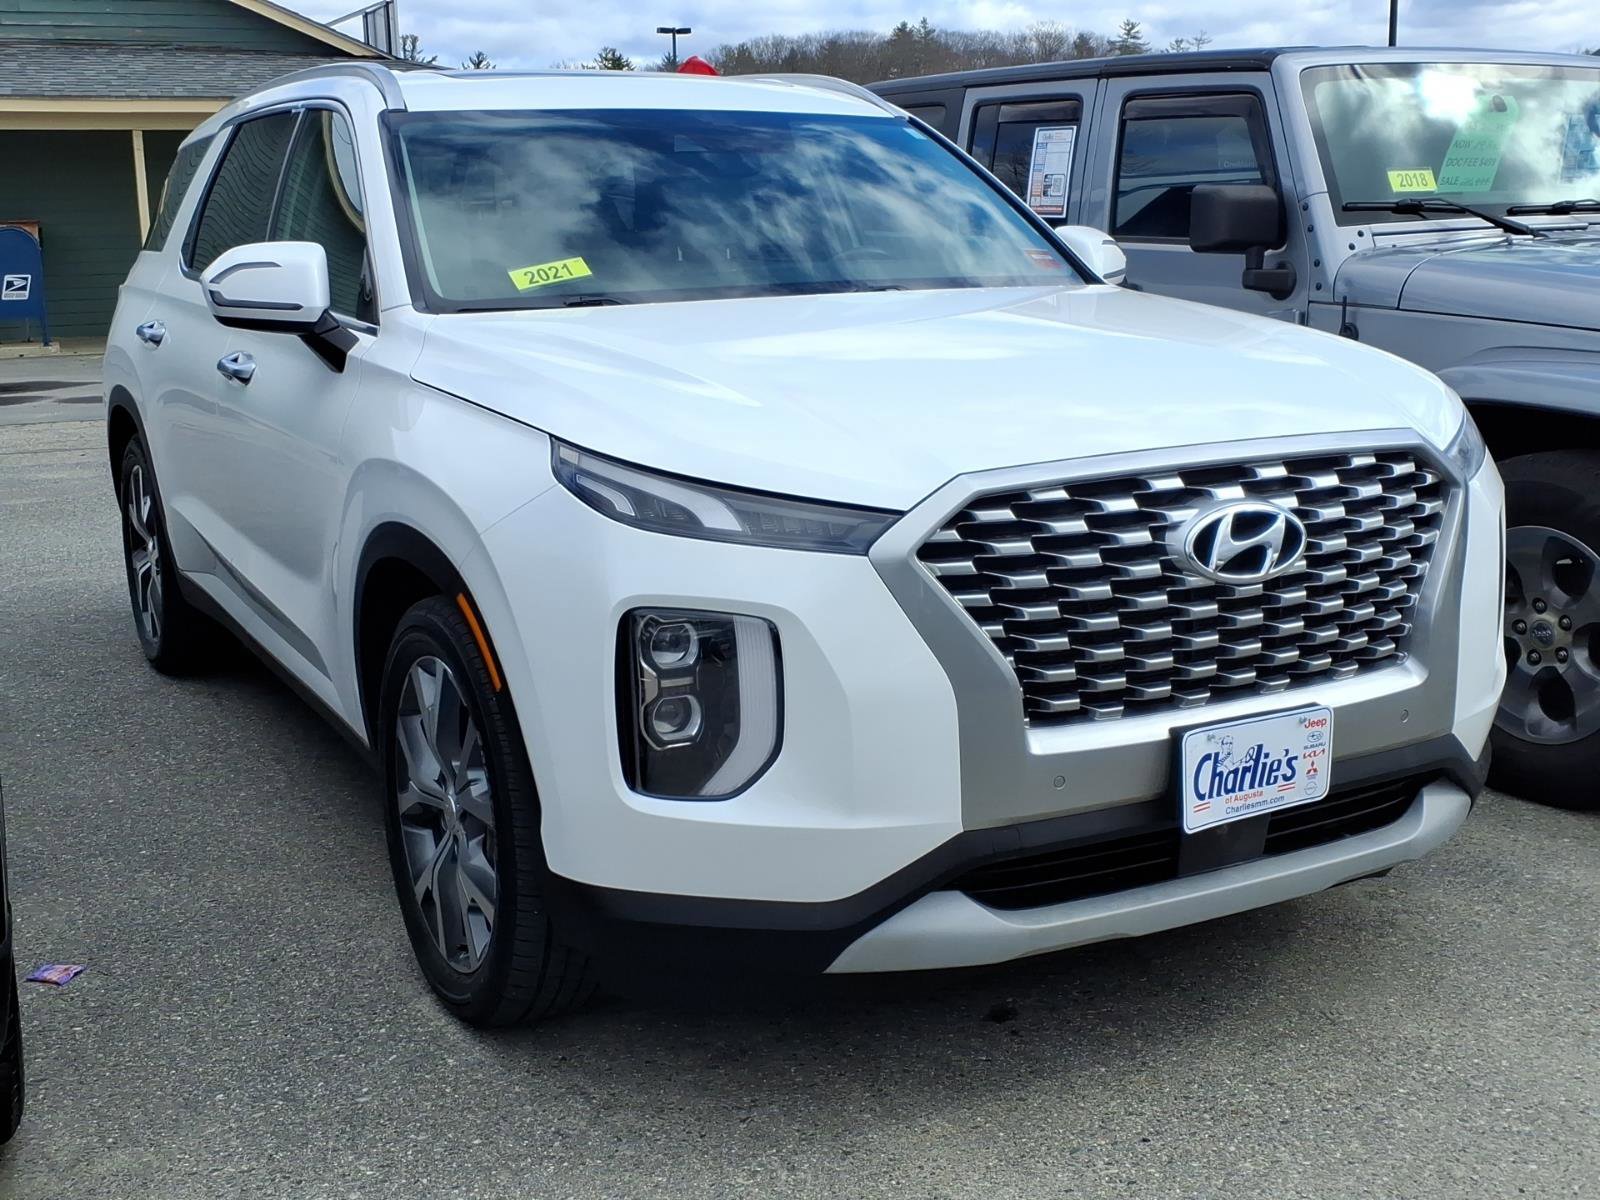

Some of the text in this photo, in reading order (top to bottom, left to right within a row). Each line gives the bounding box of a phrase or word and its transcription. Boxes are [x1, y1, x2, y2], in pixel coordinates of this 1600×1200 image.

[1397, 172, 1429, 188] 2018
[523, 263, 574, 285] 2021
[1304, 717, 1327, 729] Jeep
[1193, 743, 1299, 802] Charlie's
[1225, 789, 1264, 805] of Augusta
[1225, 794, 1285, 815] Charliesmm.com
